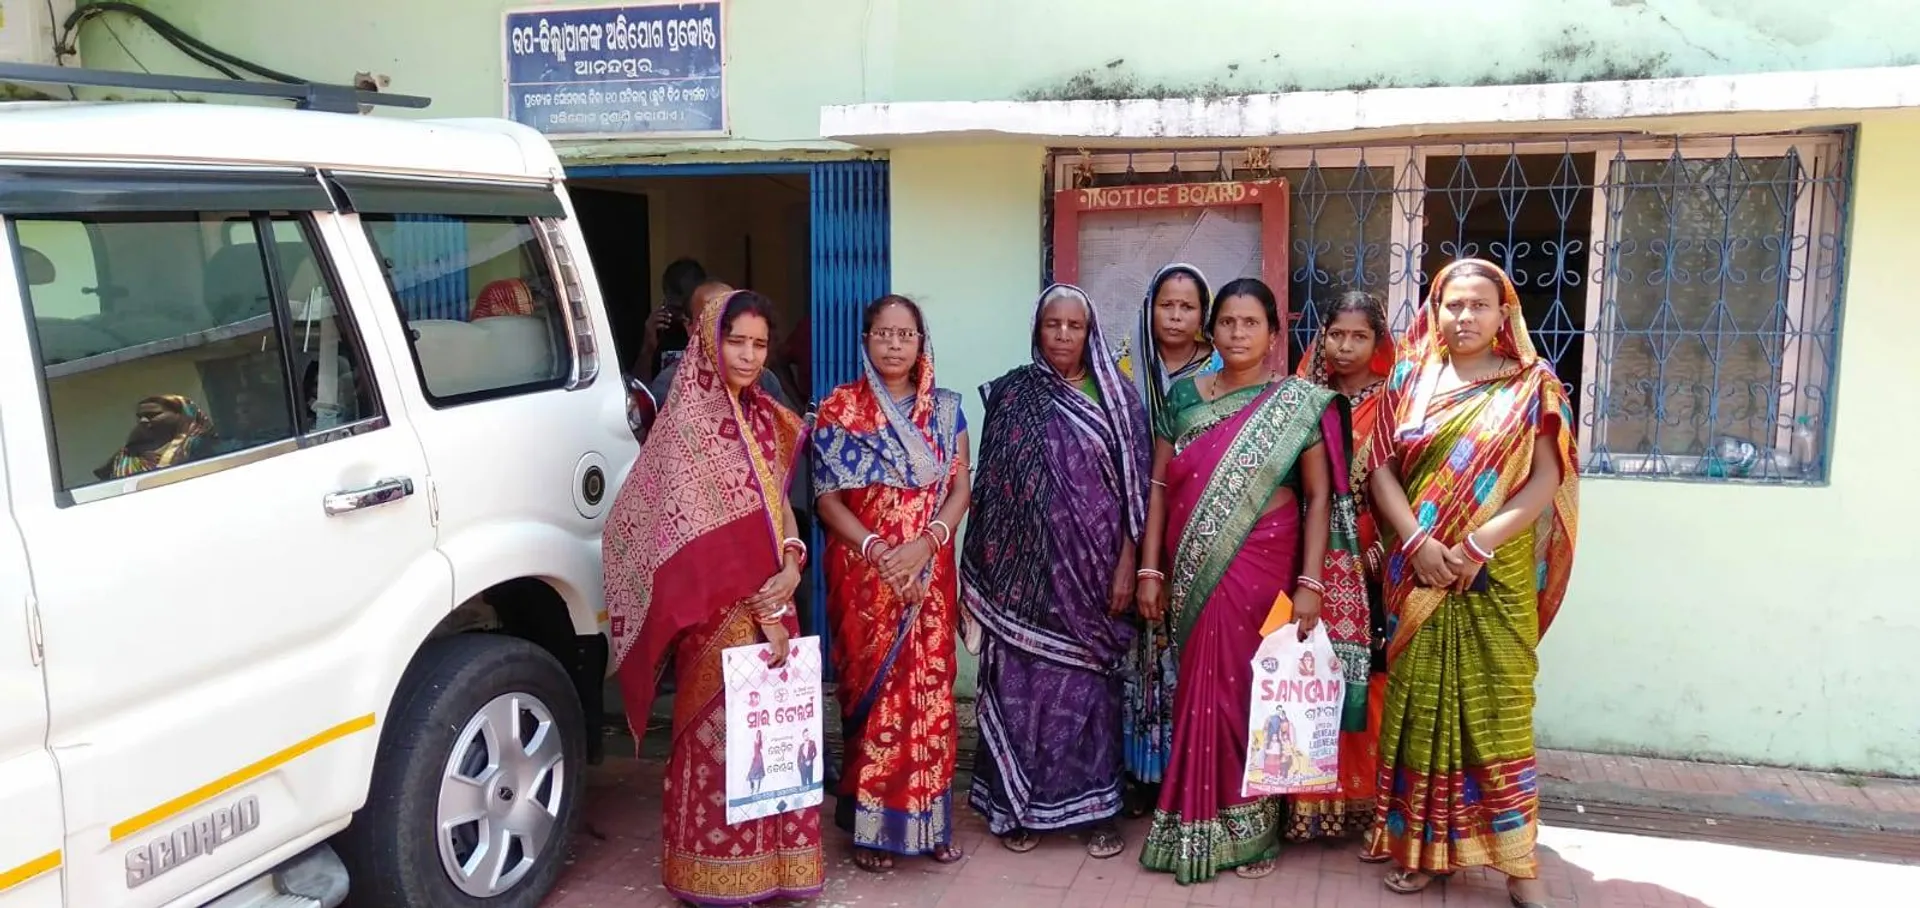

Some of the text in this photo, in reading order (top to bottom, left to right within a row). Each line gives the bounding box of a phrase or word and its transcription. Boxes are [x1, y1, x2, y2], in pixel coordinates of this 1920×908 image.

[605, 14, 664, 51] ଅଭିଯୋଗ
[667, 17, 716, 52] ପ୍ରକୋଷ୍ଠ
[574, 58, 652, 77] ଆନନ୍ଦପୁର
[1092, 184, 1246, 207] NOTICE BOARD
[125, 794, 261, 890] SCORPIO
